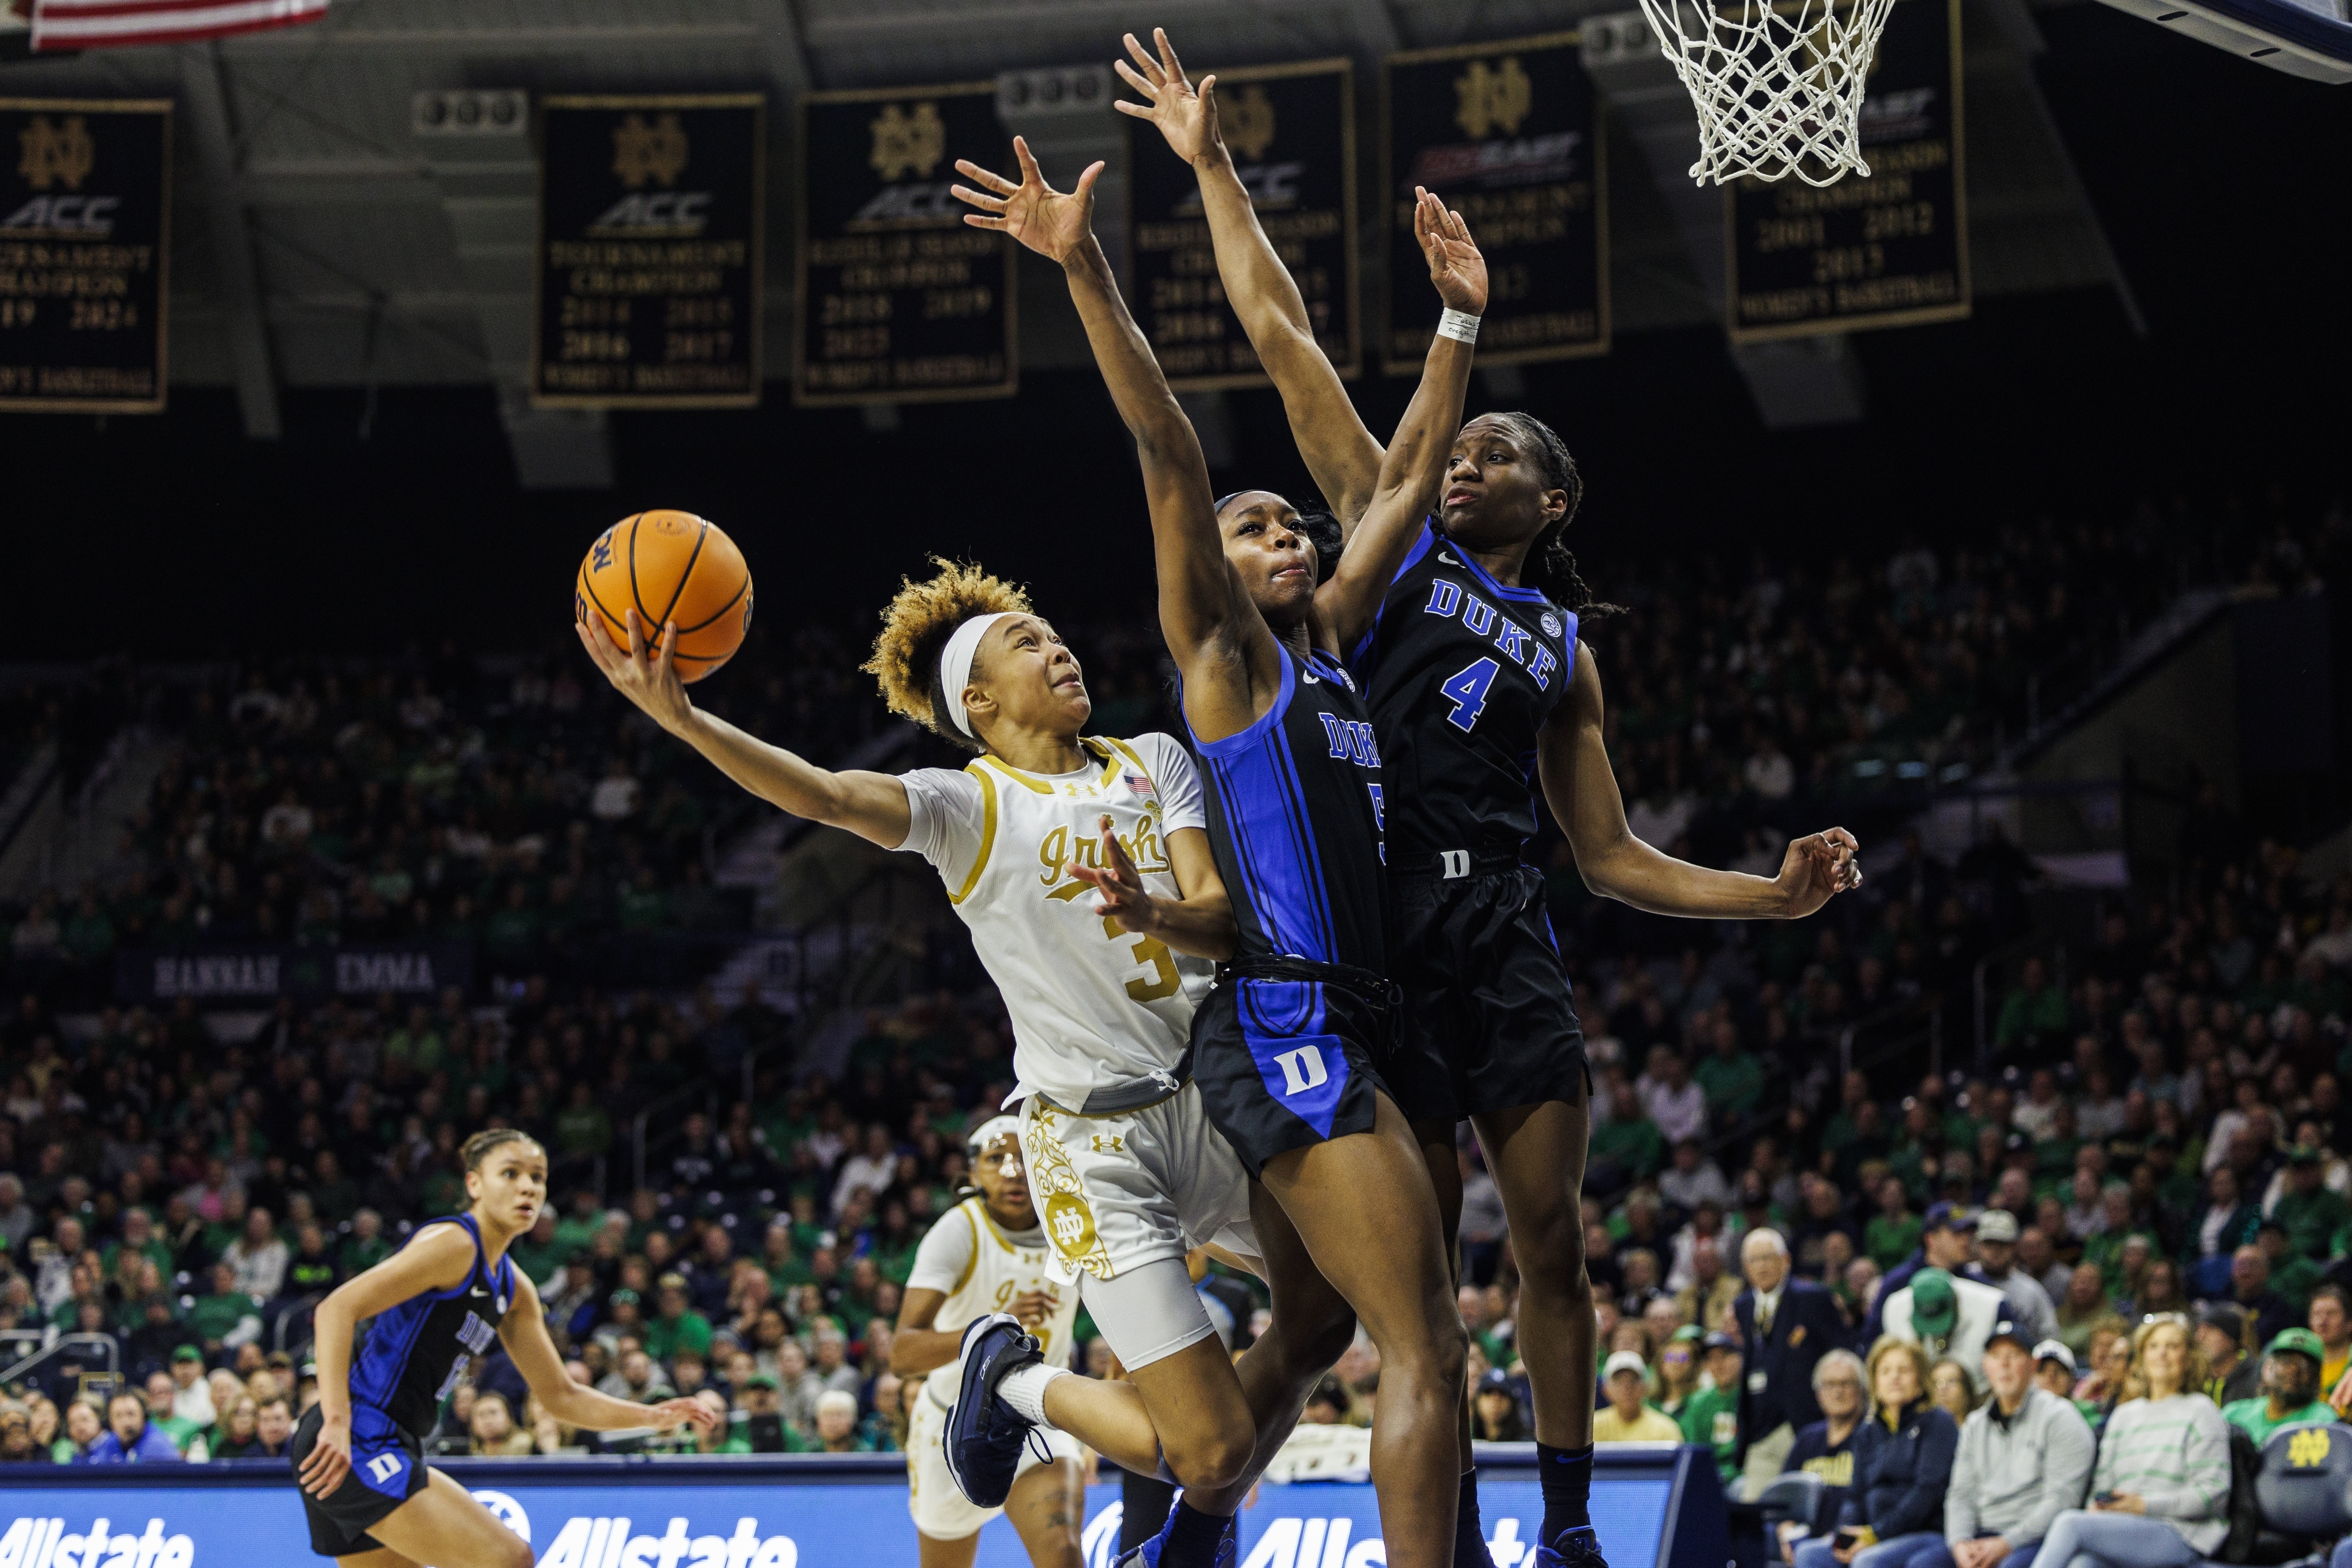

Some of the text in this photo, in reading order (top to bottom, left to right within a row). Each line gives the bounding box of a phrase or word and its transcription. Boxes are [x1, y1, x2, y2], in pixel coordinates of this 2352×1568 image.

[3, 195, 122, 230] ACC
[591, 191, 716, 228] ACC
[1424, 578, 1556, 692] DUKE
[1440, 656, 1501, 734] 4
[1318, 712, 1381, 768] DUK
[336, 954, 435, 992] EMMA
[1102, 914, 1179, 1003] 3
[0, 1517, 195, 1568] Allstate
[535, 1517, 799, 1568] Allstate
